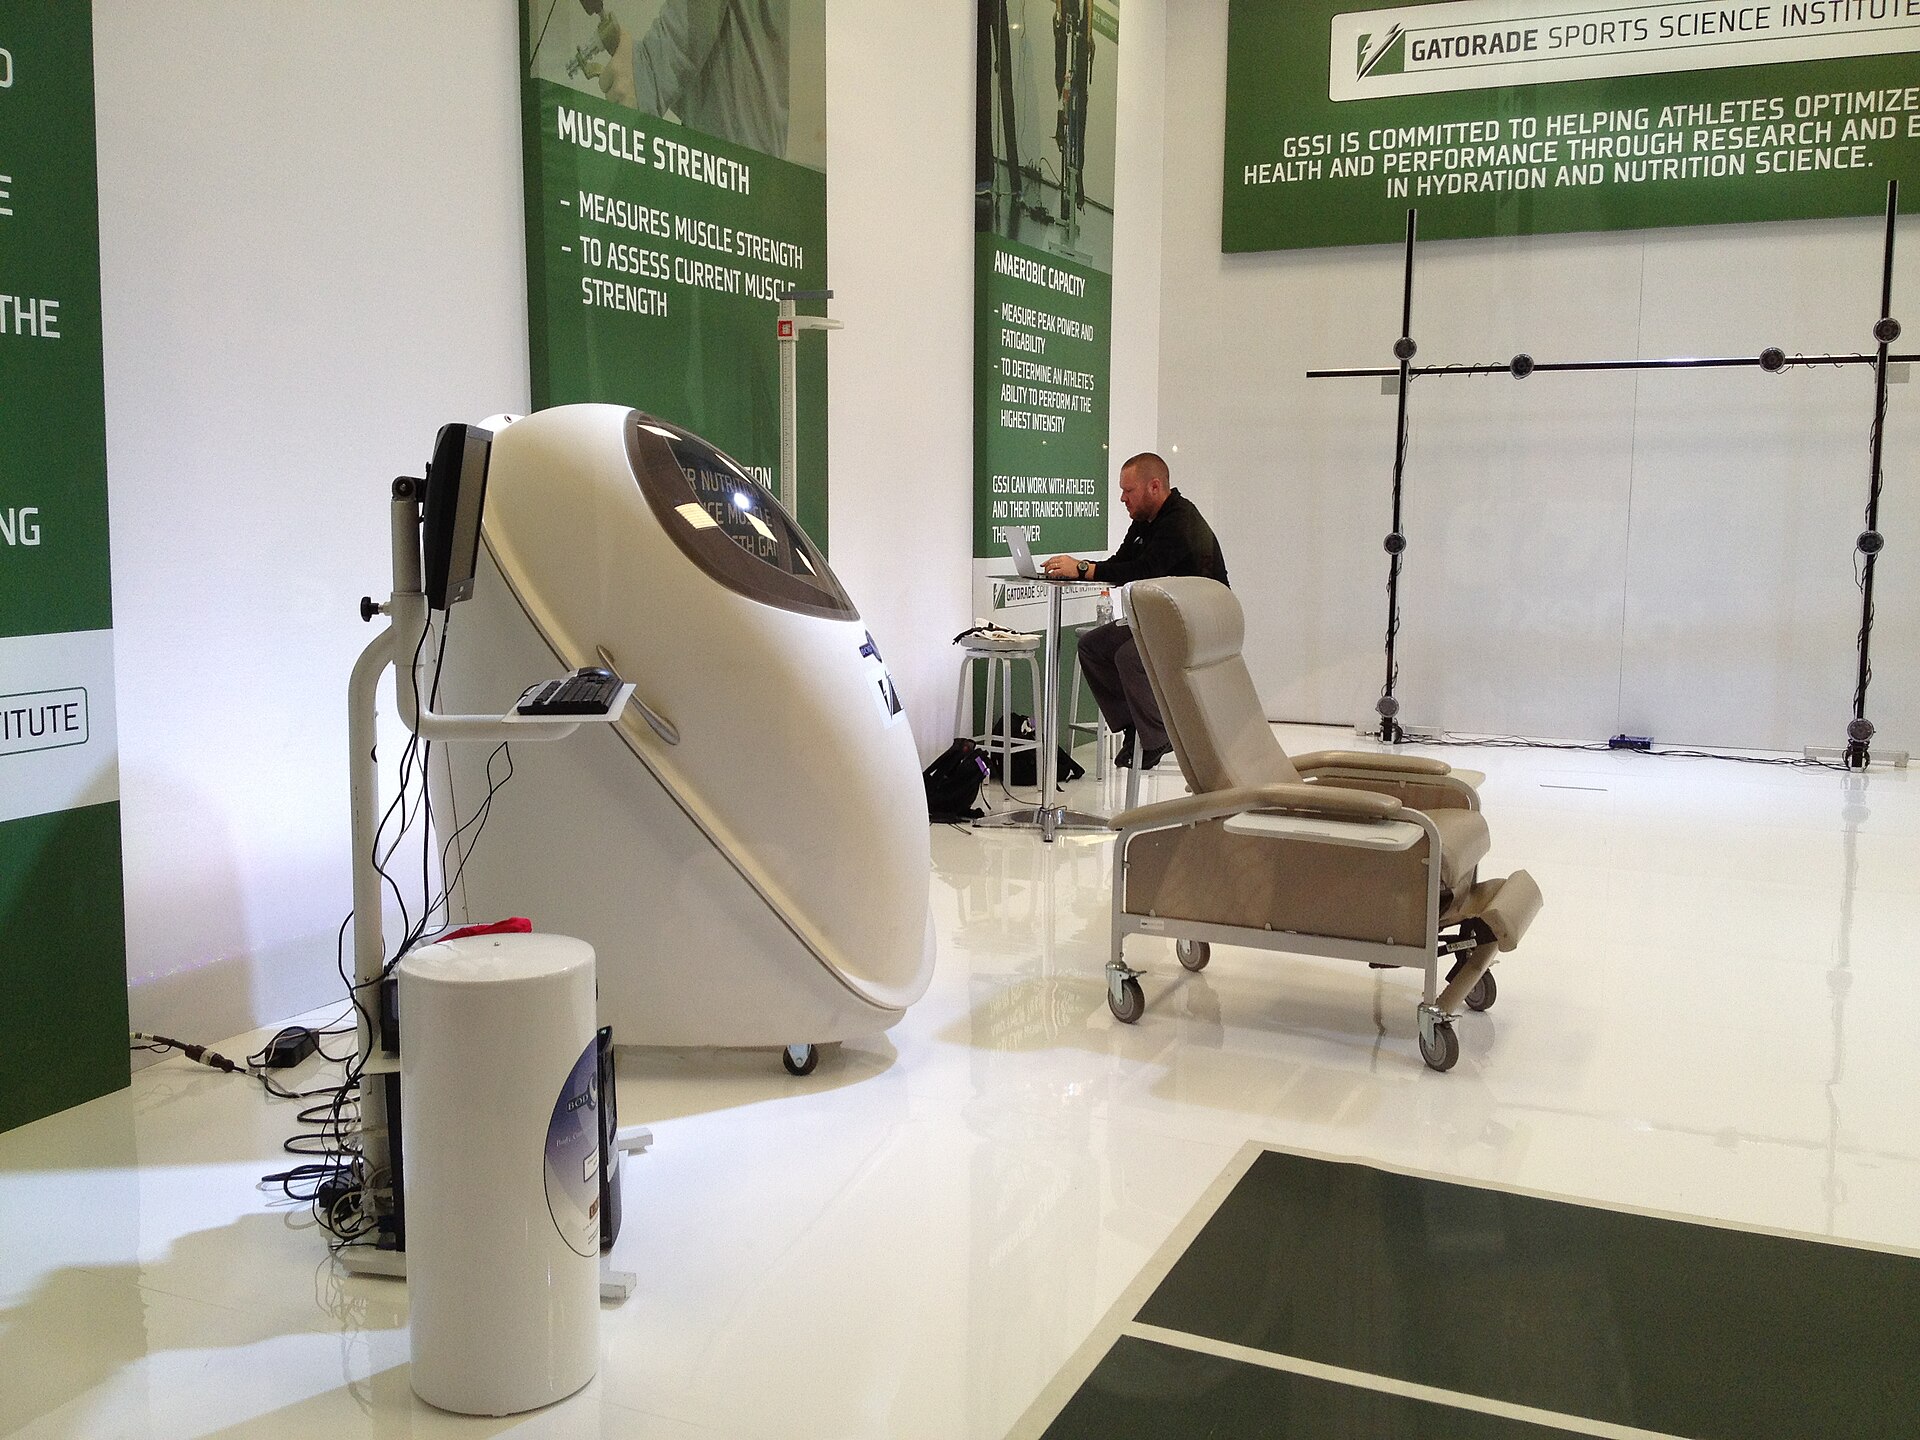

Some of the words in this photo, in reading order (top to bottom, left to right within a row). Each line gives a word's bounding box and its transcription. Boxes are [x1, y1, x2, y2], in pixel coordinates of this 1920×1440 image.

[1411, 28, 1539, 62] GATORADE
[1548, 18, 1648, 50] SPORTS
[1659, 6, 1771, 39] SCIENCE
[1283, 134, 1331, 158] GSSI
[1339, 132, 1360, 154] IS
[1368, 120, 1500, 151] COMMITTED
[1508, 117, 1537, 141] TO
[1546, 108, 1650, 138] HELPING
[1657, 97, 1785, 129] ATHLETES
[1794, 87, 1920, 119] OPTIMIZE
[557, 105, 646, 164] MUSCLE
[652, 136, 750, 195] STRENGTH
[1244, 159, 1322, 185] HEALTH
[1329, 155, 1374, 179] AND
[1383, 140, 1558, 174] PERFORMANCE
[1566, 132, 1683, 161] THROUGH
[1693, 121, 1832, 152] RESEARCH
[1841, 116, 1897, 142] AND
[1386, 177, 1408, 199] IN
[1416, 167, 1546, 197] HYDRATION
[1554, 163, 1604, 187] AND
[1613, 153, 1746, 184] NUTRITION
[1754, 145, 1874, 174] SCIENCE.
[579, 190, 670, 238] MEASURES
[675, 215, 733, 253] MUSCLE
[736, 231, 803, 270] STRENGTH
[579, 235, 601, 267] TO
[607, 242, 670, 280] ASSESS
[675, 256, 742, 294] CURRENT
[994, 249, 1046, 287] ANAEROBIC
[1048, 266, 1086, 298] CAPACITY
[581, 276, 668, 317] STRENGTH
[1001, 302, 1037, 328] MEASURE
[1037, 311, 1056, 332] PEAK
[1056, 317, 1080, 338] POWER
[1080, 324, 1094, 342] AND
[1001, 328, 1046, 355] FATIGABILITY
[1001, 357, 1011, 377] TO
[1012, 360, 1052, 383] DETERMINE
[1053, 367, 1063, 385] AN
[1063, 370, 1094, 391] ATHLETE'S
[1001, 383, 1027, 405] ABILITY
[1028, 388, 1038, 406] TO
[1038, 389, 1071, 410] PERFORM
[1071, 395, 1080, 411] AT
[1079, 395, 1092, 413] THE
[1000, 409, 1032, 430] HIGHEST
[1032, 413, 1066, 433] INTENSITY
[992, 475, 1010, 493] GSSI
[1011, 476, 1026, 494] CAN
[1026, 476, 1048, 494] WORK
[1048, 477, 1065, 494] WITH
[1065, 478, 1095, 495] ATHLETES
[992, 500, 1008, 518] AND
[1009, 500, 1030, 518] THEIR
[1031, 501, 1064, 518] TRAINERS
[1064, 501, 1073, 517] TO
[1073, 501, 1100, 517] IMPROVE
[1006, 585, 1036, 602] GATORADE
[0, 702, 79, 740] ITUTE
